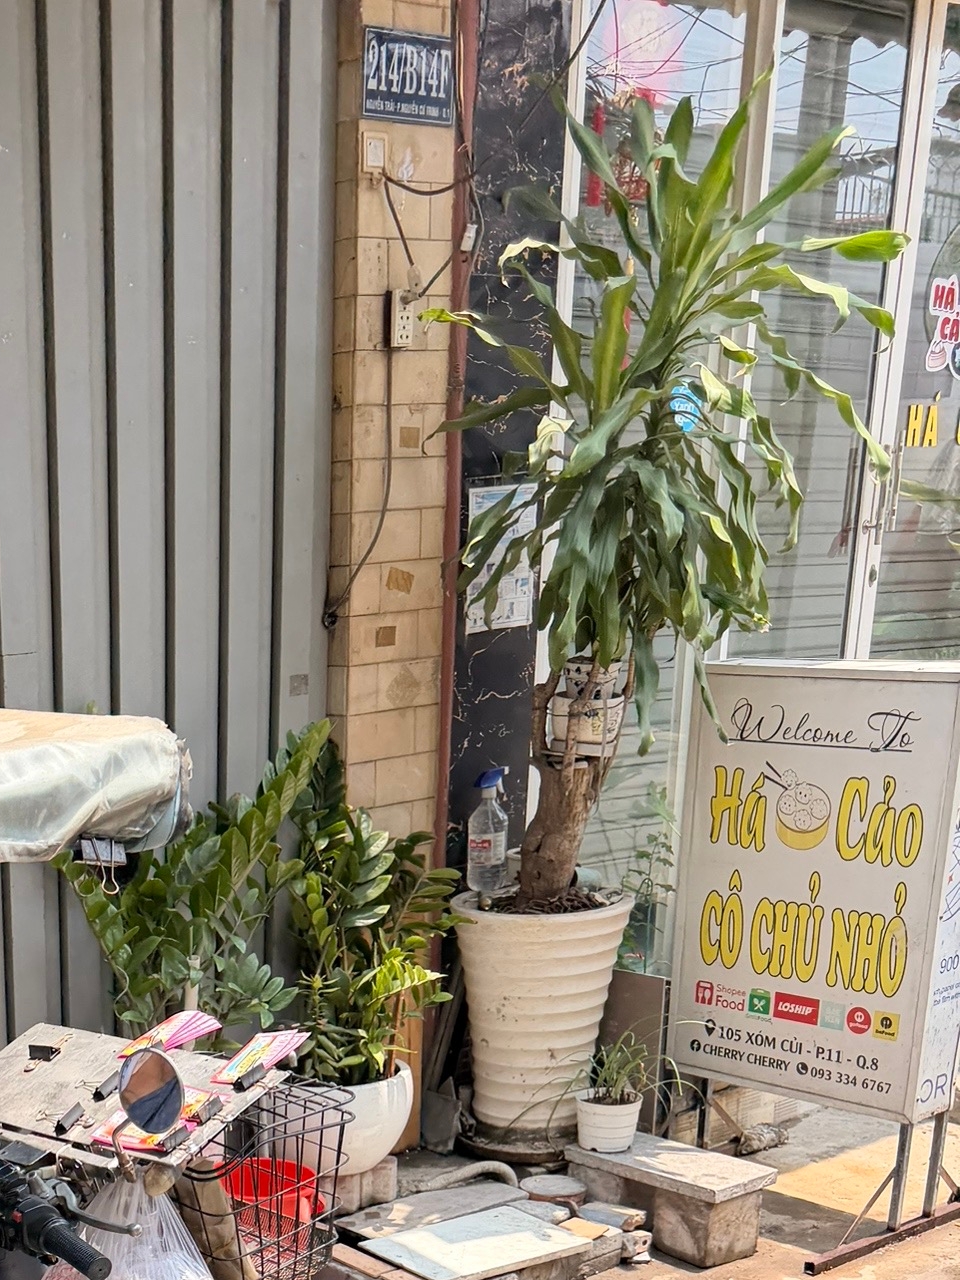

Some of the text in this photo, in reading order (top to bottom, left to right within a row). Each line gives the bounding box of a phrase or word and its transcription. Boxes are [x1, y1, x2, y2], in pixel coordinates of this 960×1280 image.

[367, 40, 452, 98] 214/B14F
[932, 281, 957, 310] HÁ
[907, 390, 941, 448] HÁ
[731, 697, 922, 752] Welcome To
[710, 765, 924, 868] Há Cảo
[700, 869, 909, 998] CÔ CHỦ NHỎ
[715, 995, 745, 1012] Food
[716, 984, 747, 997] Shopee
[777, 1001, 818, 1016] LOSHIP
[702, 1043, 892, 1094] CHERRY CHERRY 093 334 6767
[745, 1030, 776, 1049] XÓM
[780, 1036, 803, 1055] CỦI
[815, 1045, 843, 1064] P.11
[856, 1055, 880, 1072] Q.8
